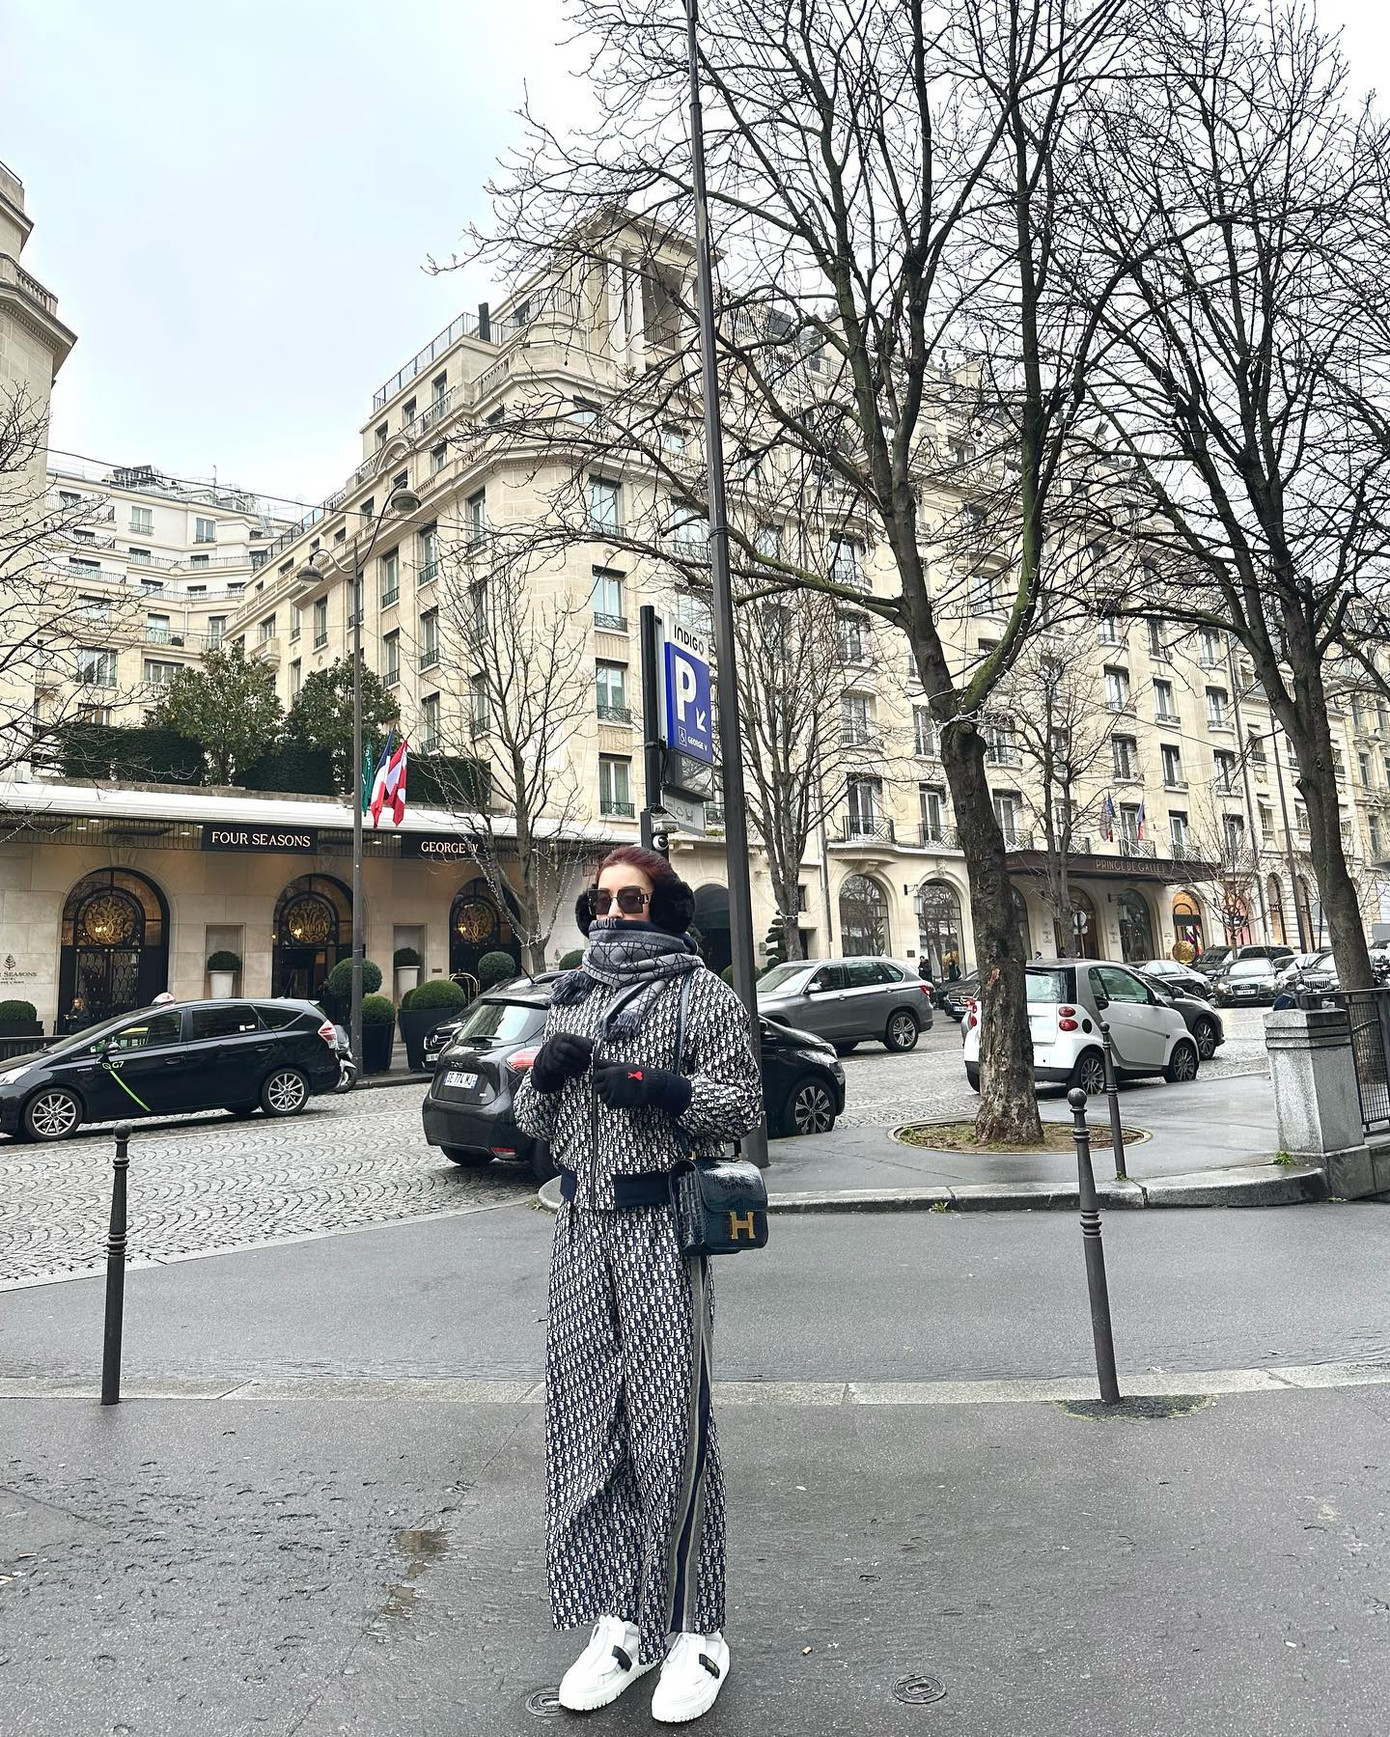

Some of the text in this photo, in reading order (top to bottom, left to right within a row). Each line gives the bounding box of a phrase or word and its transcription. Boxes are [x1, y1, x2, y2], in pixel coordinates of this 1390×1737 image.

[674, 624, 705, 656] INDIGO
[675, 654, 697, 722] P
[212, 831, 311, 848] FOUR SEASONS
[421, 841, 466, 854] GEORGE
[1096, 860, 1125, 871] PRINCE
[1127, 861, 1137, 872] DE
[112, 1061, 124, 1069] G7
[730, 1211, 756, 1239] H
